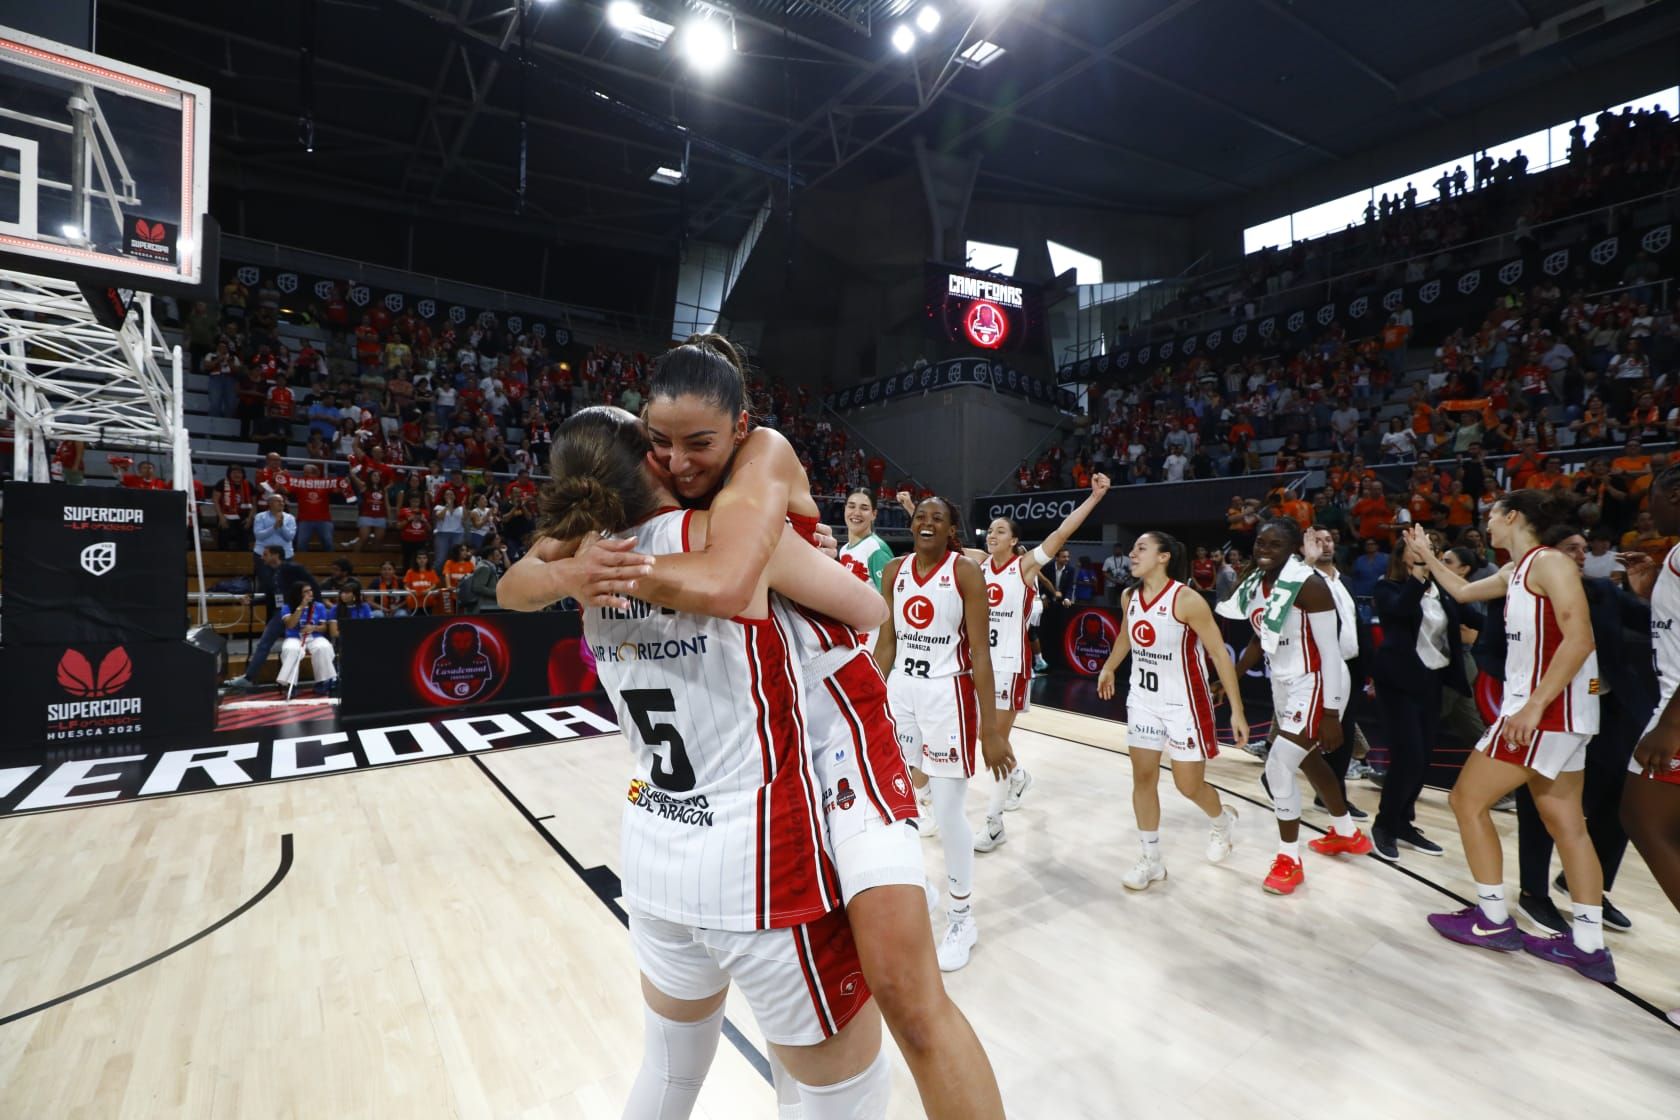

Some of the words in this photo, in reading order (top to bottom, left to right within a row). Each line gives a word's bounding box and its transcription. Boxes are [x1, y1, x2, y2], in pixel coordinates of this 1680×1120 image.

[131, 239, 169, 254] SUPERCOPA
[948, 274, 1023, 306] CAMPEONAS
[63, 506, 144, 523] SUPERCOPA
[989, 497, 1076, 520] endesa
[608, 635, 708, 662] HORIZONT
[904, 657, 931, 679] 33
[1138, 667, 1159, 692] 10
[47, 697, 142, 721] SUPERCOPA
[47, 728, 103, 741] HUESCA
[108, 724, 142, 735] 2025
[620, 688, 696, 792] 5
[0, 705, 620, 811] ERCOPA
[657, 803, 714, 827] ARAGON
